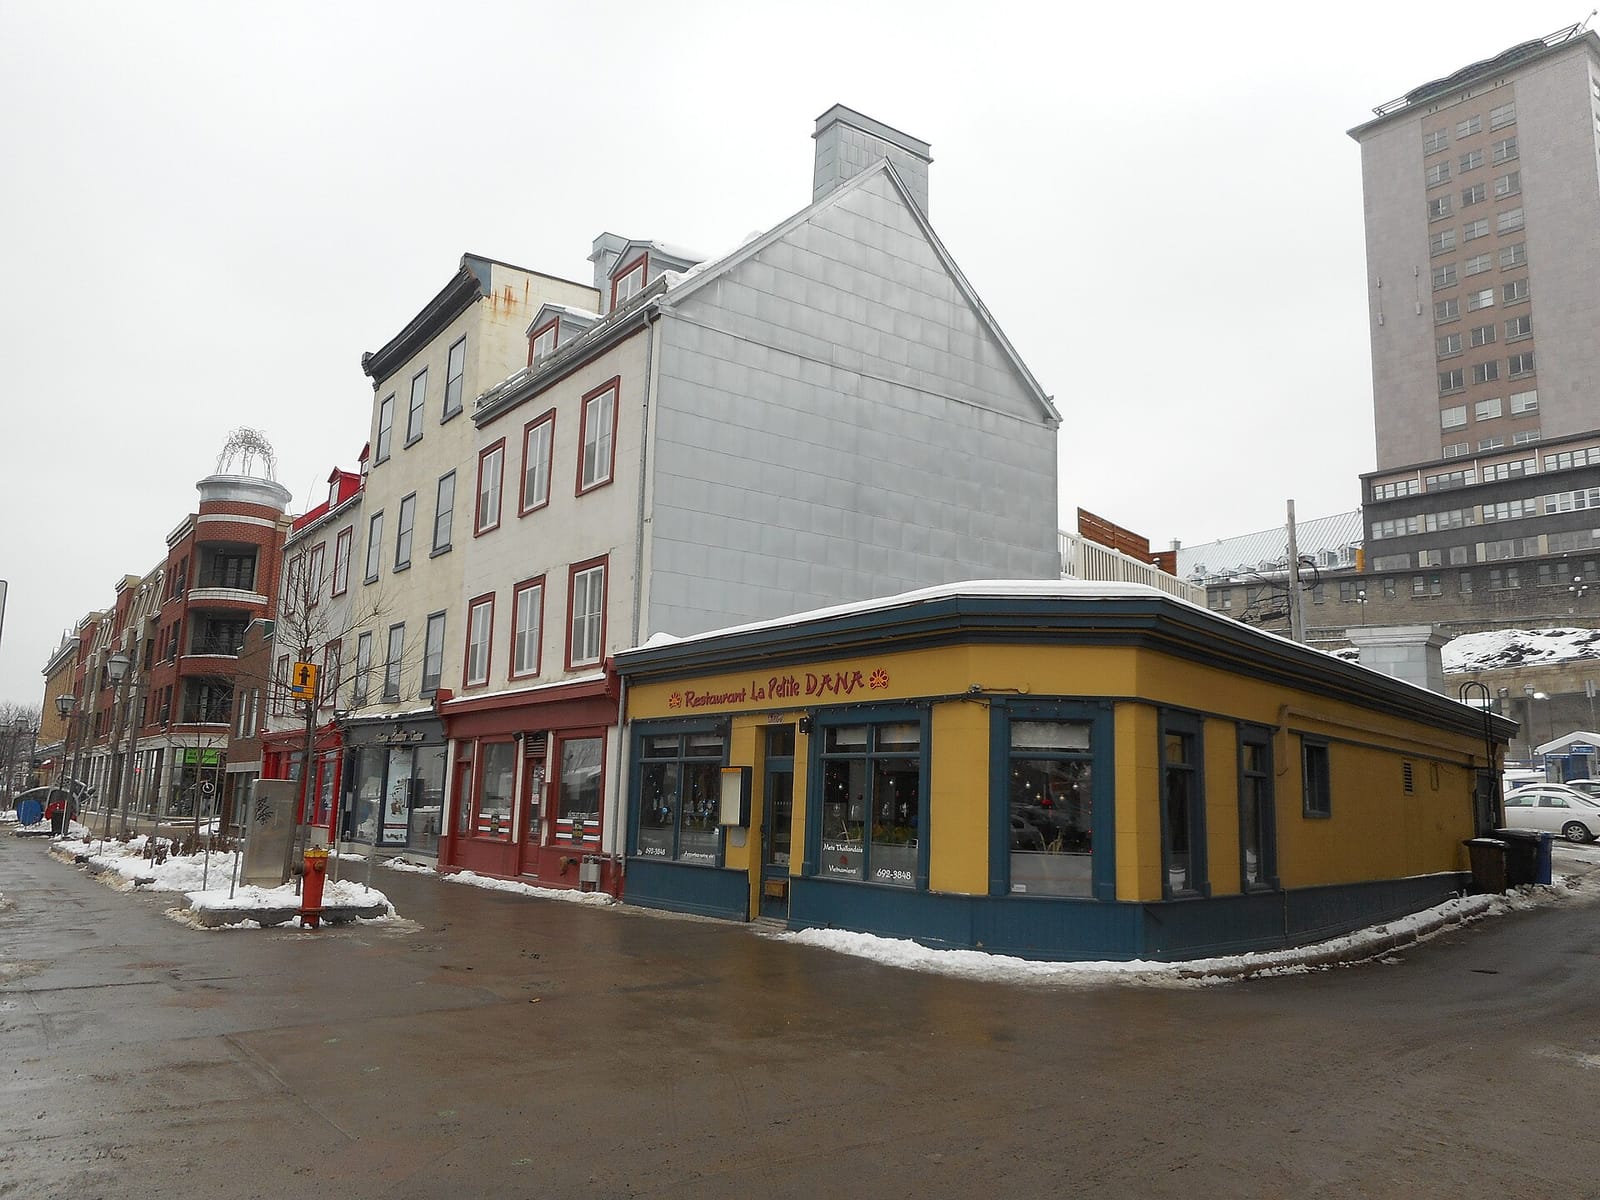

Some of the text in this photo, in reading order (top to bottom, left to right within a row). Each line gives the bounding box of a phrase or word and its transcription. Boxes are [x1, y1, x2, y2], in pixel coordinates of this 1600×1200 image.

[685, 671, 865, 707] Restaurant La Petite DANA
[876, 868, 912, 880] 692-3848
